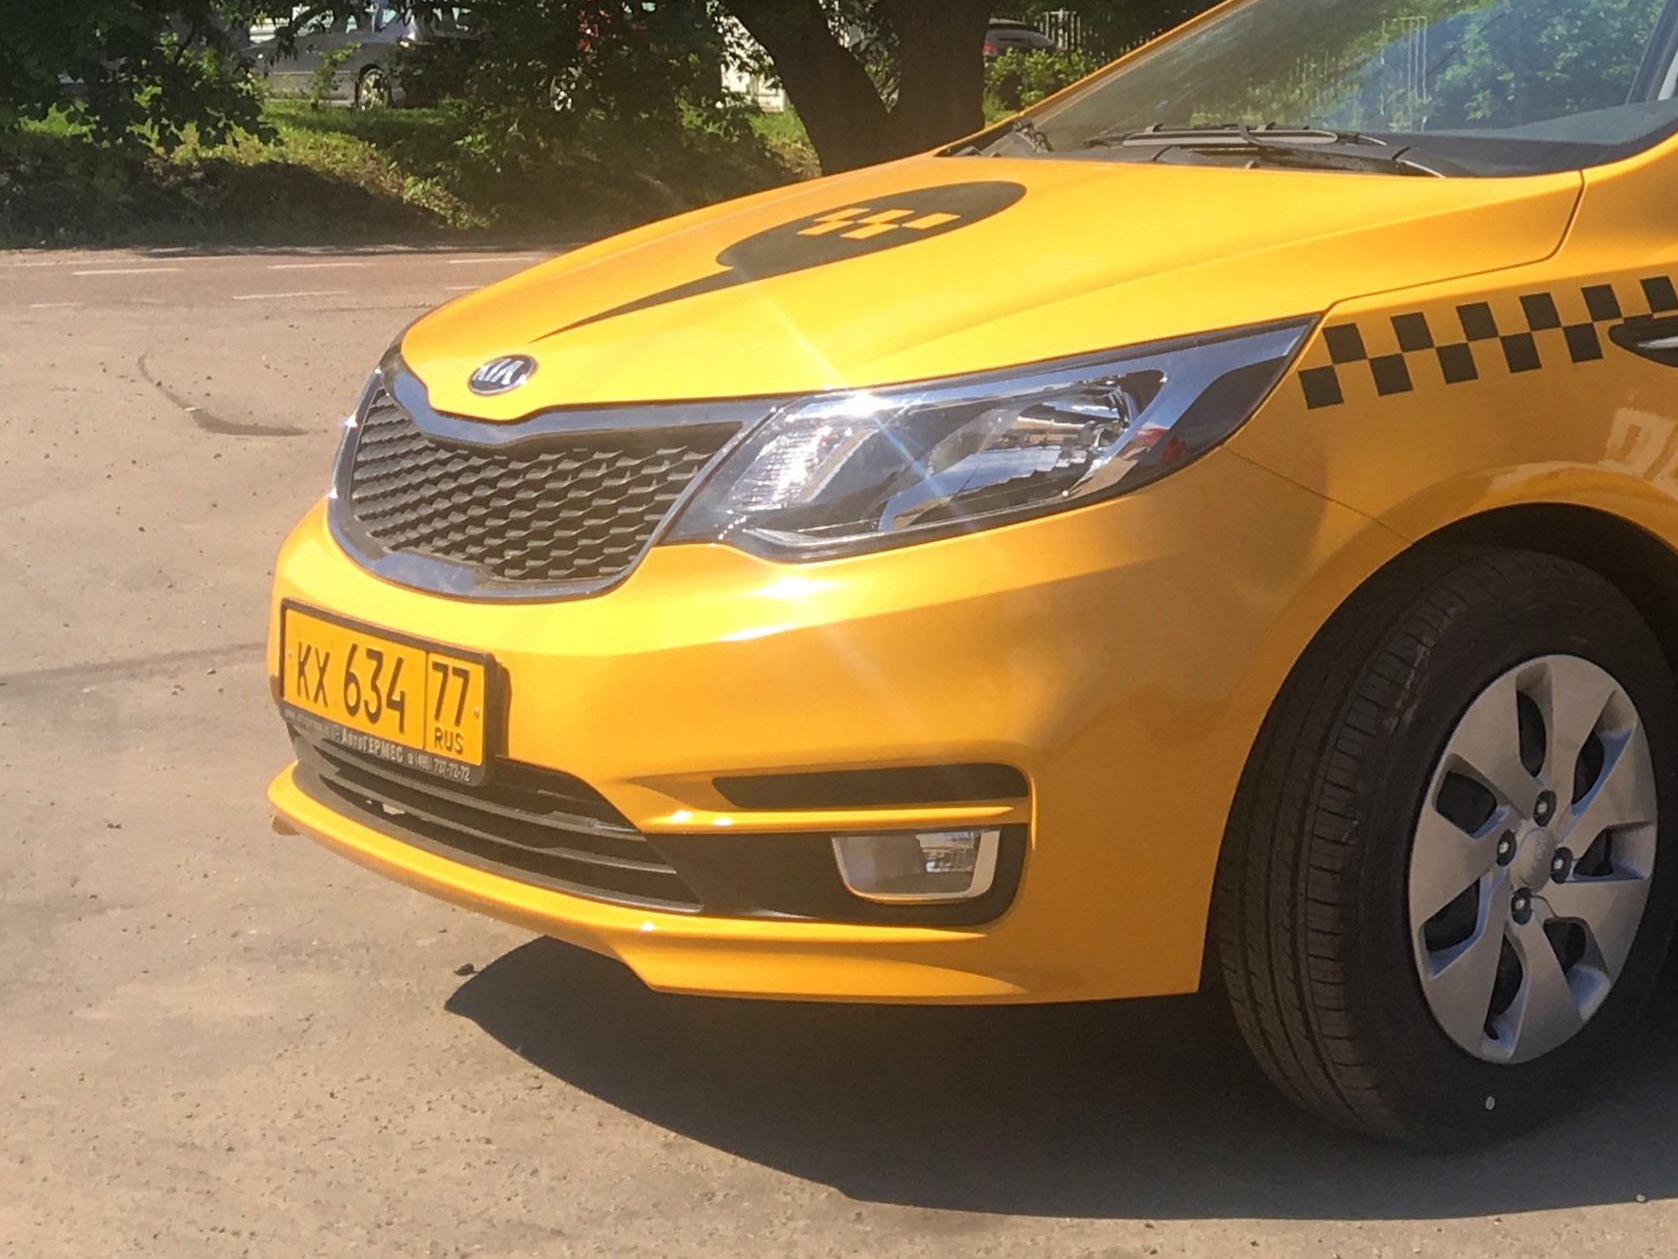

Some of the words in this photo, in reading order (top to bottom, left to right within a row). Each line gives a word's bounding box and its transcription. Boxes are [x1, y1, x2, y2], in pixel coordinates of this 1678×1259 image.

[343, 643, 405, 734] 634
[431, 661, 469, 727] 77
[434, 727, 463, 755] RUS
